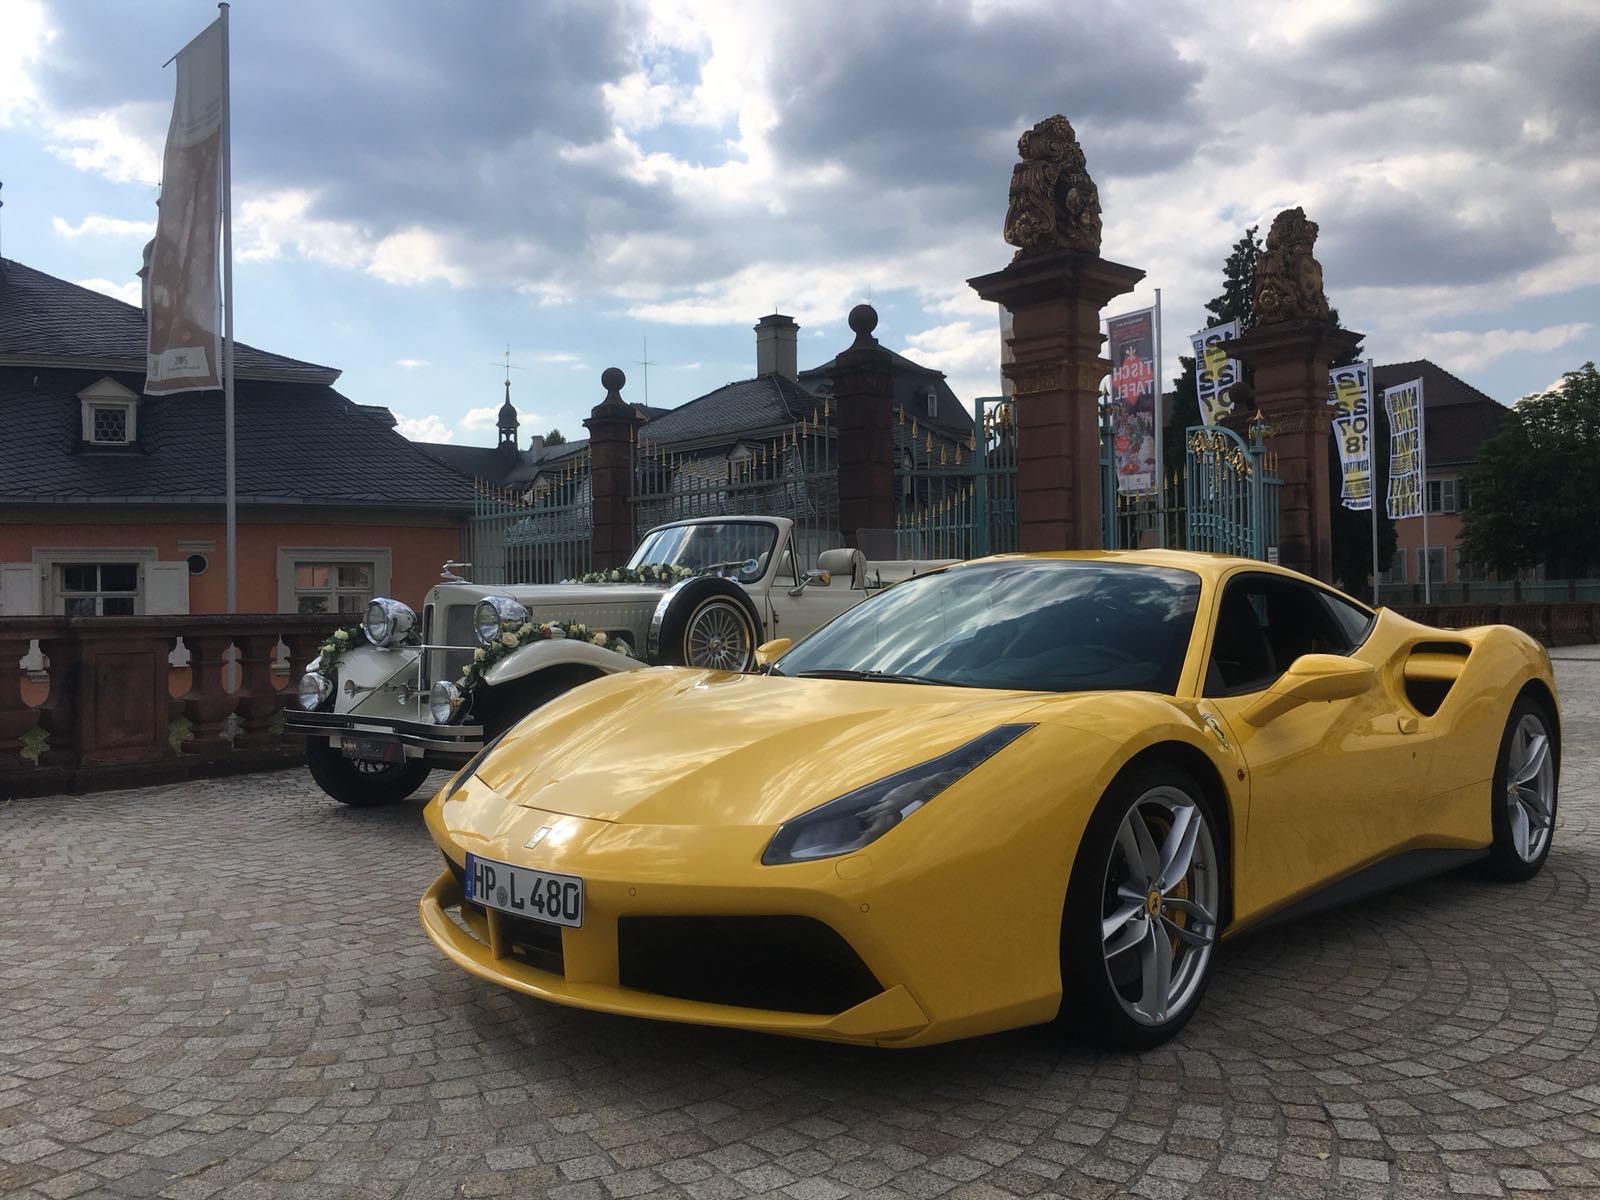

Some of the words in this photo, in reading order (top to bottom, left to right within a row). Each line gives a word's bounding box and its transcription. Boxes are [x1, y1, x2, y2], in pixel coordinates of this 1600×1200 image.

[473, 861, 496, 900] HP
[510, 872, 524, 910] L
[530, 877, 580, 920] 480
